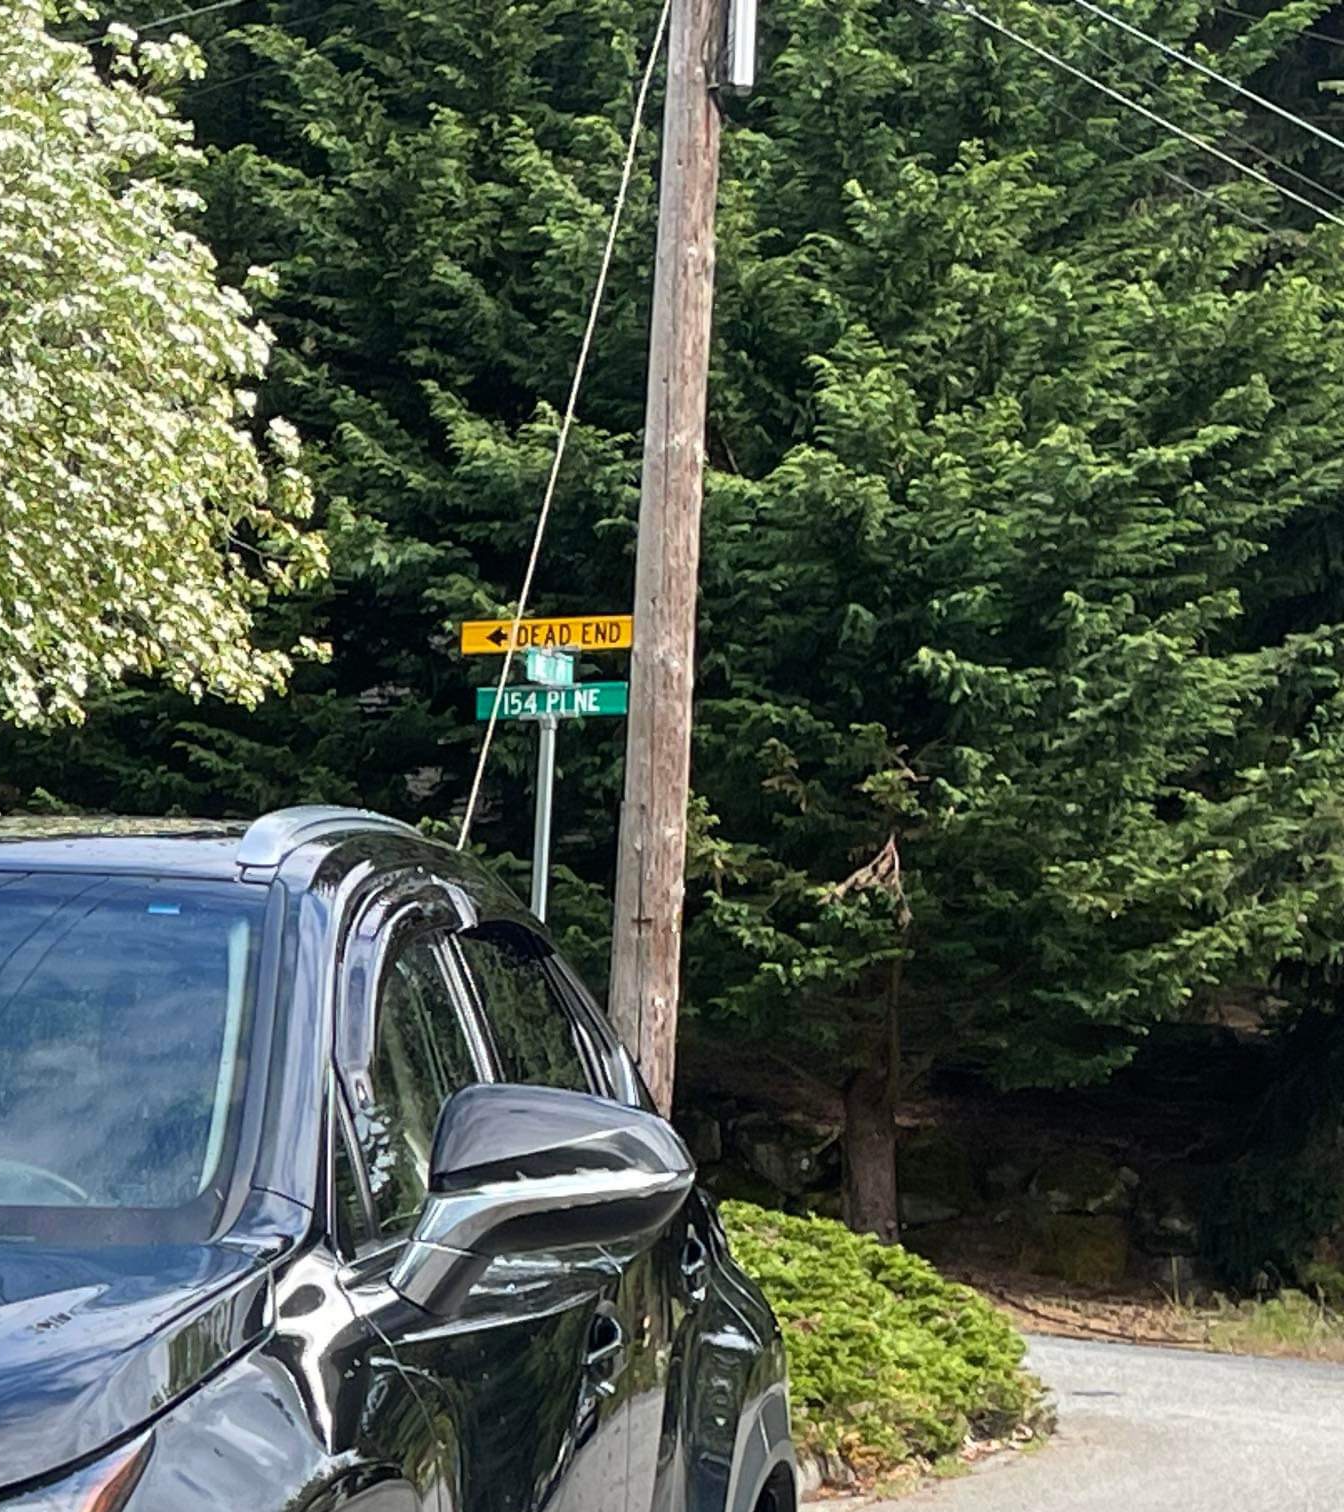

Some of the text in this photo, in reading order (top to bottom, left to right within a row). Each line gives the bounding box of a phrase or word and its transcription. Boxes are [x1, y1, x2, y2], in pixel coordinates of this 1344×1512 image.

[517, 621, 621, 648] DEAD END
[503, 692, 538, 716] 154
[574, 688, 601, 717] NE
